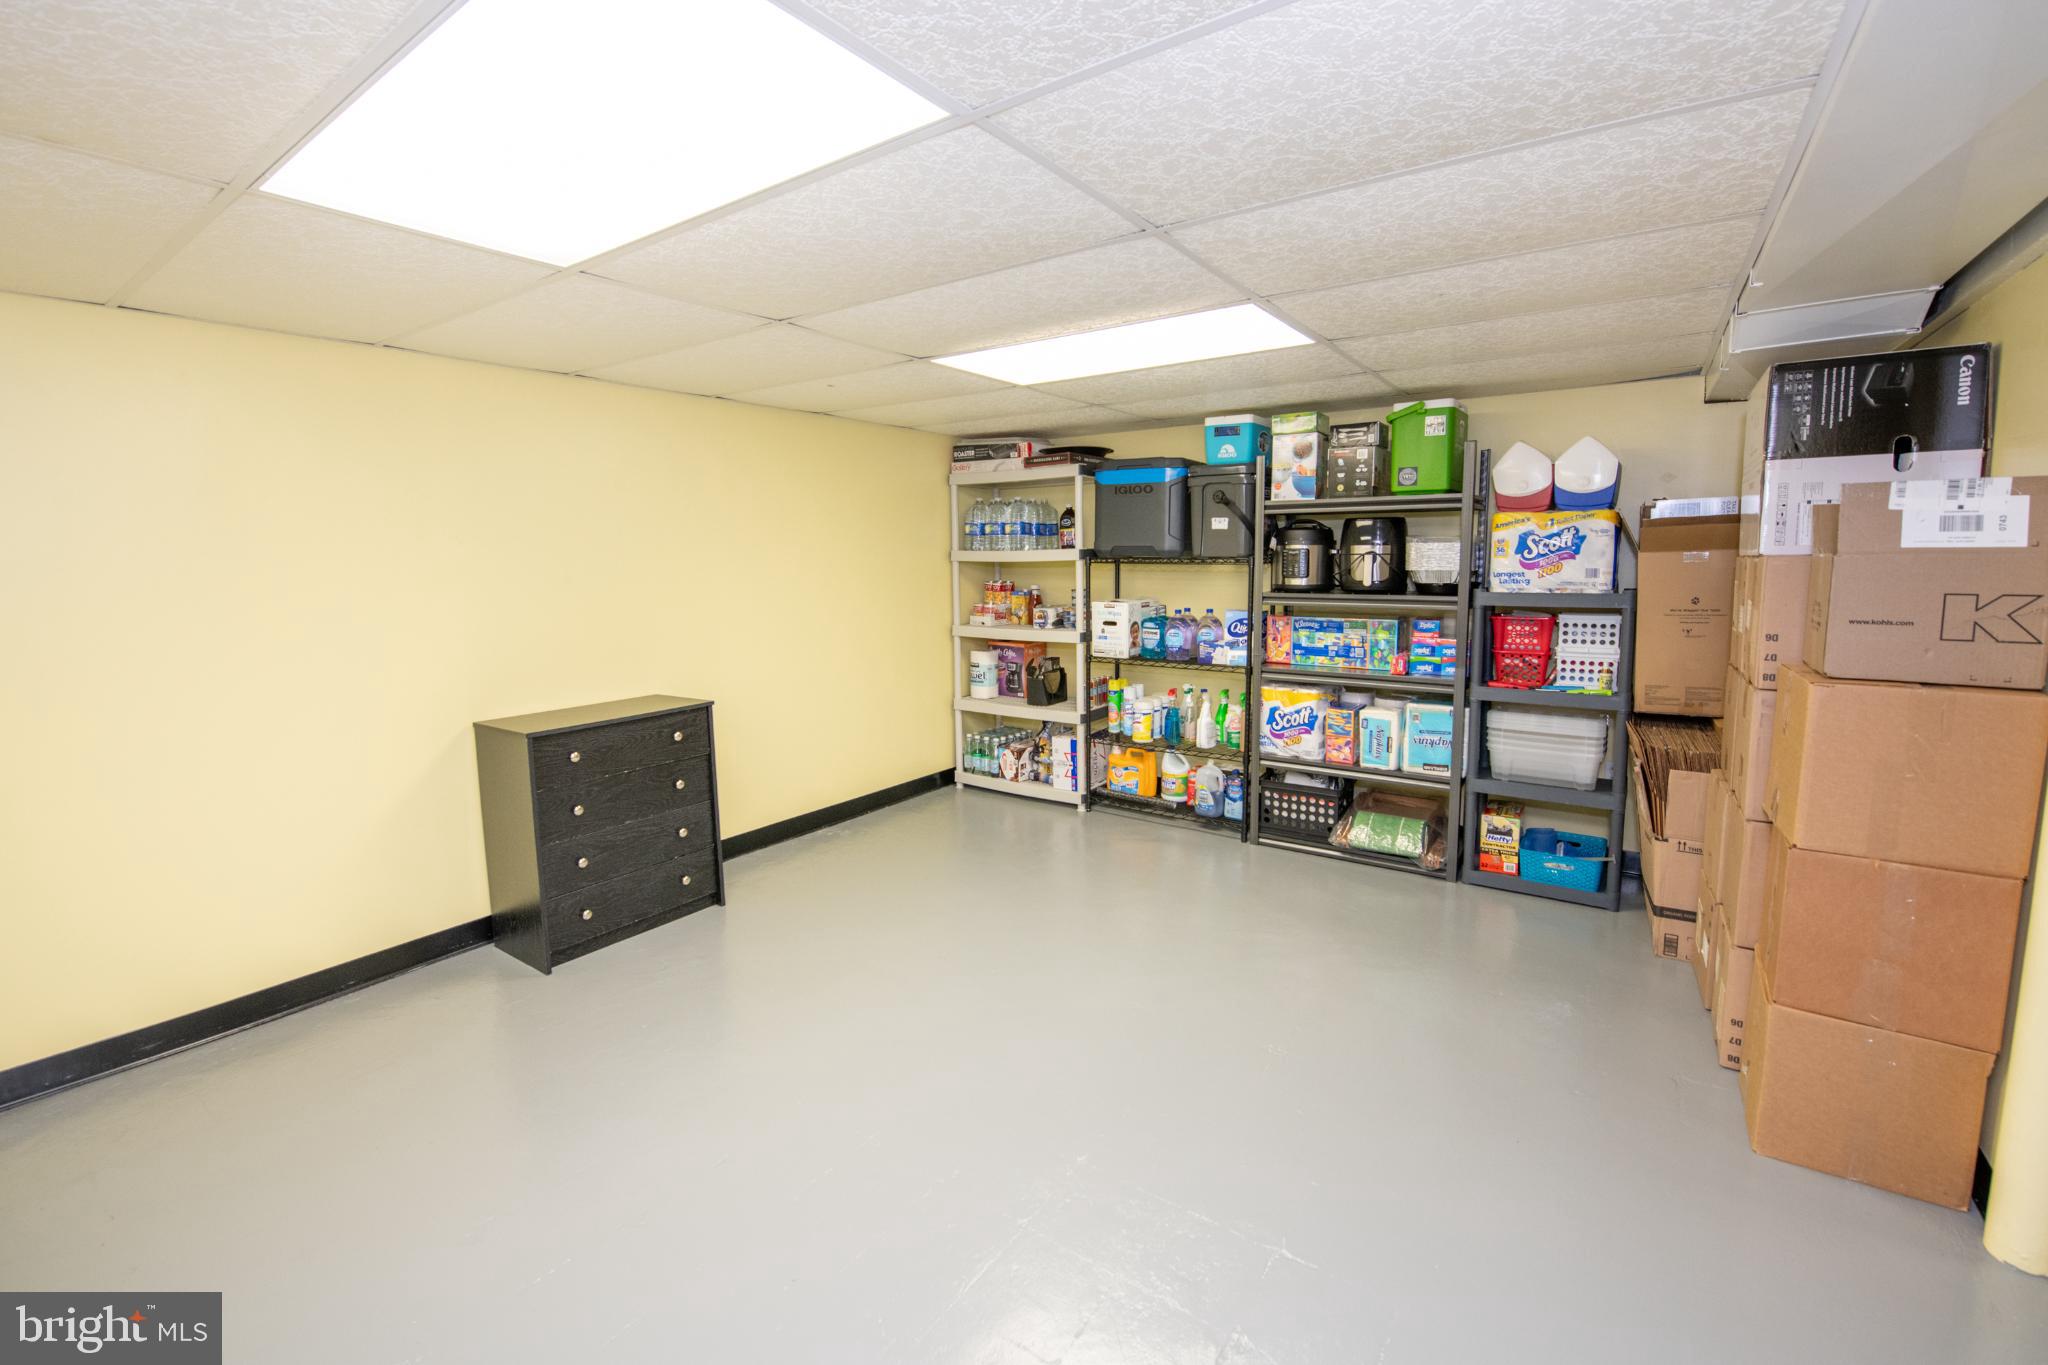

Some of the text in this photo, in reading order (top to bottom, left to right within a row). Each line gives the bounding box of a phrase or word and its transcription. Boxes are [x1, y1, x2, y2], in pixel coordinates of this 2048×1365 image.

[1956, 354, 1976, 406] Canon
[1114, 484, 1154, 496] IGLOO
[1495, 517, 1531, 529] America's
[1522, 526, 1577, 559] Scott
[1493, 571, 1526, 580] Longest
[1498, 578, 1531, 586] Lasting
[1848, 593, 2044, 645] www.kohls.com K
[1765, 633, 1779, 642] D6
[1764, 653, 1777, 662] D7
[1272, 706, 1312, 730] Scott
[1487, 834, 1511, 844] Hefty
[1730, 1018, 1744, 1029] D6
[1729, 1036, 1742, 1047] D7
